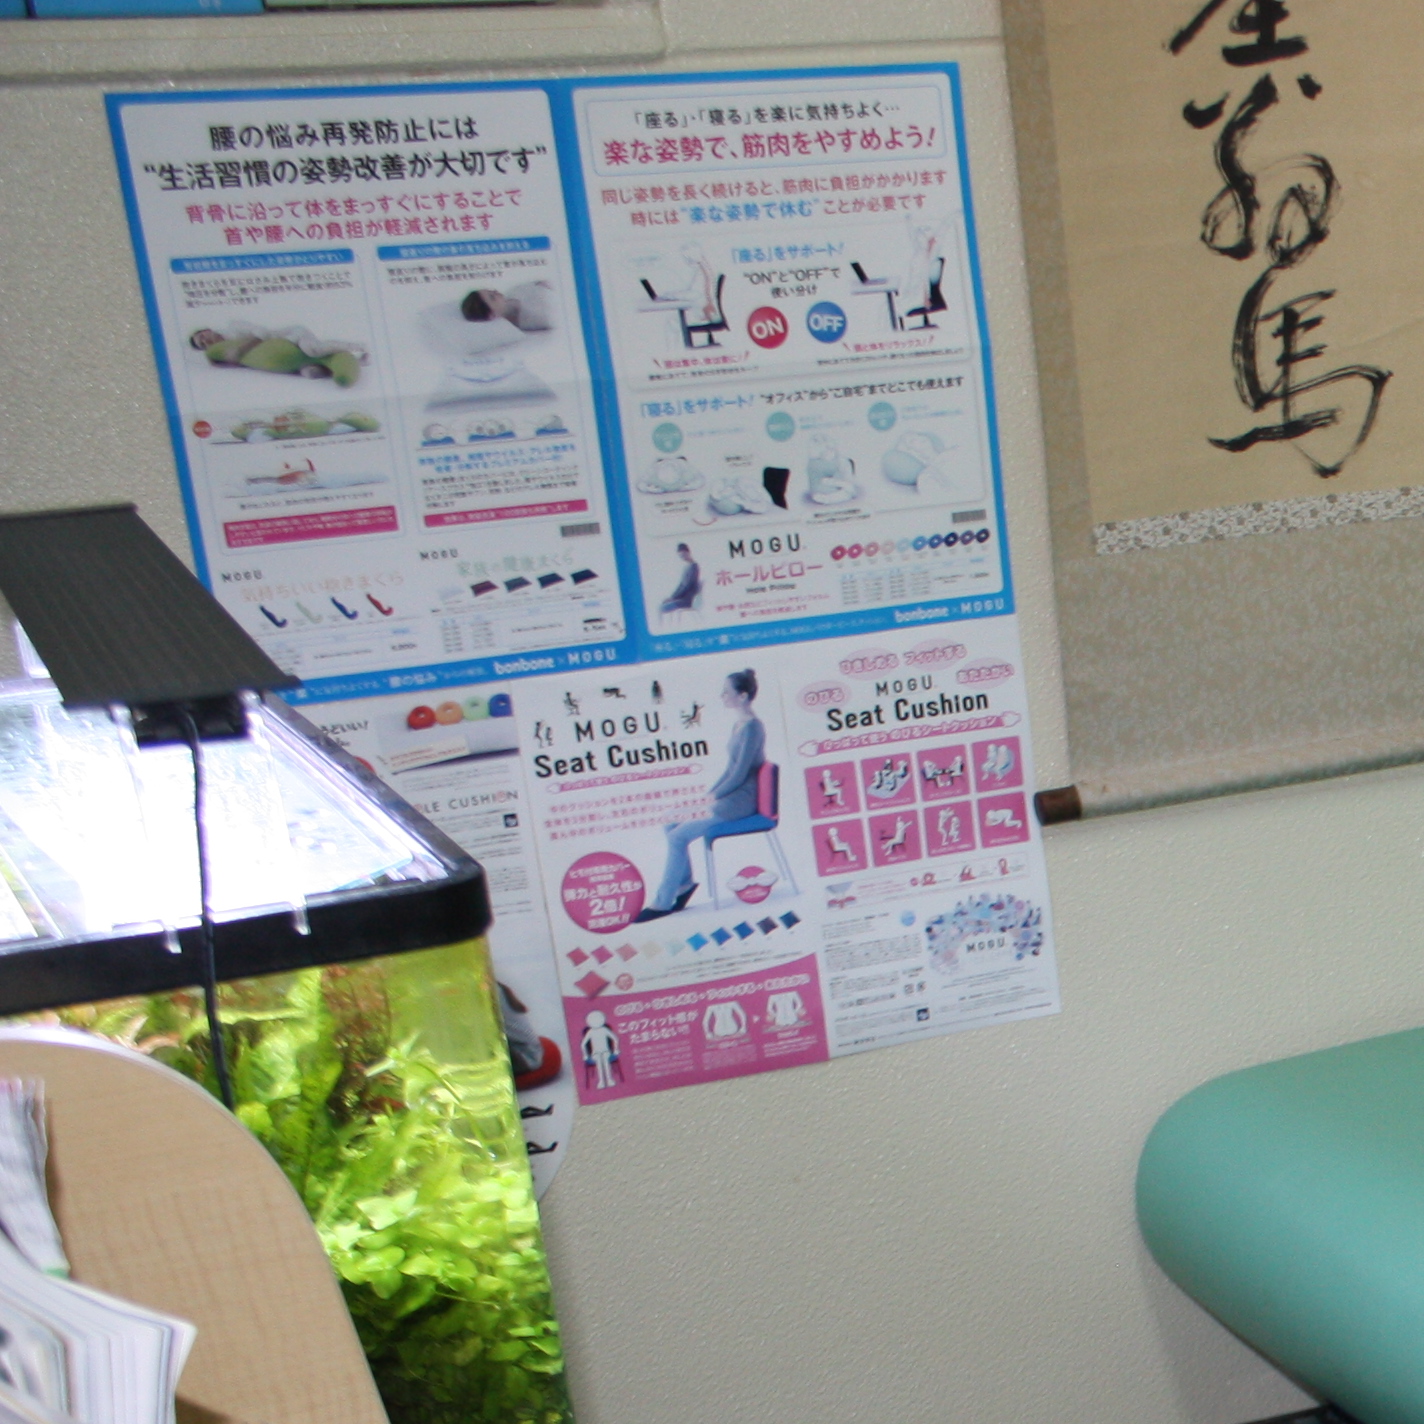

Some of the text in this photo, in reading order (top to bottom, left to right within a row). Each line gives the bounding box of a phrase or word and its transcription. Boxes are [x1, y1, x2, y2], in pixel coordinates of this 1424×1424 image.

[209, 115, 478, 151] 腰の悩み再発防止には
[602, 170, 948, 205] 同じ姿勢を長く続けると、筋肉に負担がかかります
[185, 189, 522, 225] 背骨に沿って体をまっすぐにすることで
[224, 214, 494, 247] 首や腰への負担が軽減されます
[770, 284, 817, 299] 使い分け
[752, 316, 784, 340] ON
[808, 314, 845, 333] OFF
[729, 534, 801, 558] MOGU
[568, 647, 617, 666] MOGU
[876, 675, 934, 696] MOGU
[575, 711, 661, 744] MOGU
[827, 693, 989, 732] Seat Cushion
[534, 738, 709, 779] Seat Cushion
